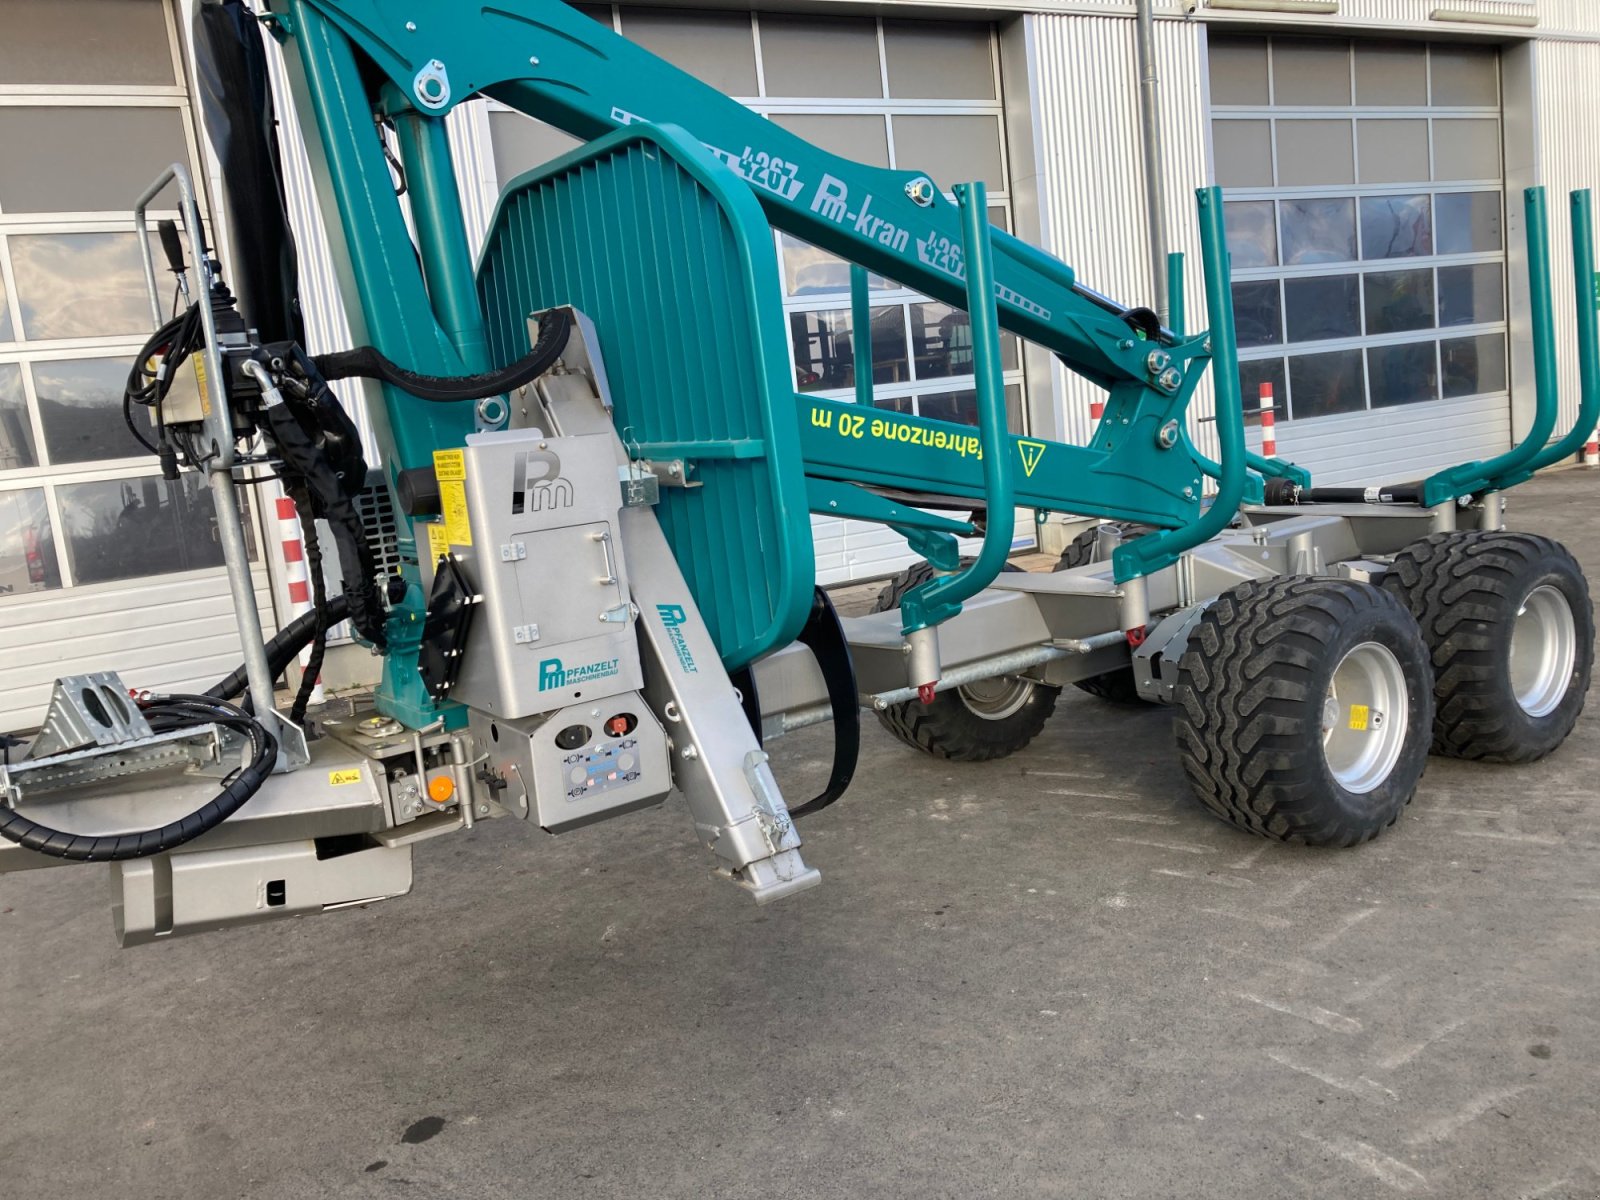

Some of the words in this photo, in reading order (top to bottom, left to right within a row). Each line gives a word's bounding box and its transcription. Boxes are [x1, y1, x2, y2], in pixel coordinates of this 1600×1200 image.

[739, 146, 799, 196] 4267
[811, 408, 832, 428] m
[838, 413, 865, 439] 20
[871, 419, 983, 460] fahrenzone
[672, 627, 698, 674] PFANZELT
[566, 659, 619, 679] PFANZELT
[566, 669, 619, 686] MASCHINENBAU
